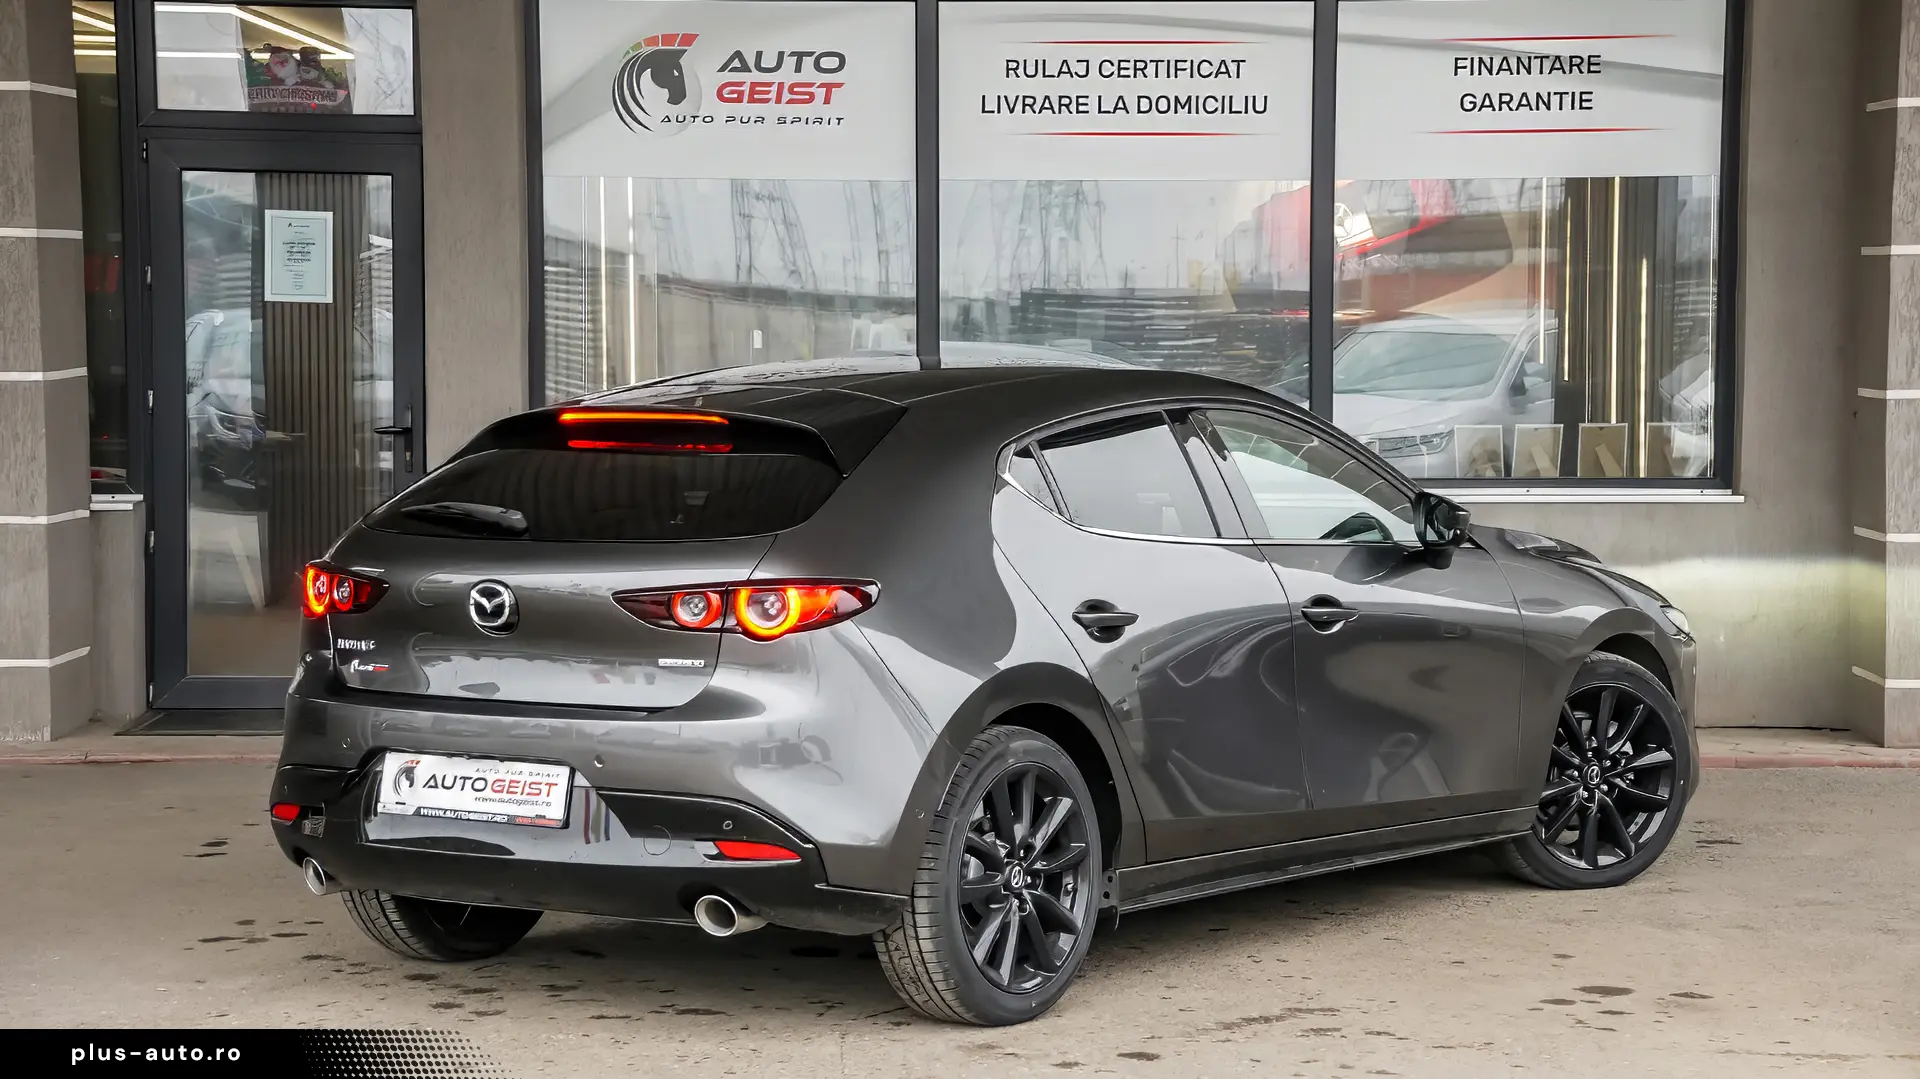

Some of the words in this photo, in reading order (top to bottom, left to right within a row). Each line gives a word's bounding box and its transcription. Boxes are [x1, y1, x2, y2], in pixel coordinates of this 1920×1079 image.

[716, 49, 847, 74] AUTO
[1004, 59, 1090, 79] RULAJ
[1098, 59, 1247, 79] CERTIFICAT
[1453, 55, 1602, 76] FINANTARE
[716, 81, 847, 105] GEIST
[1459, 91, 1594, 112] GARANTIE
[980, 95, 1090, 115] LIVRARE
[1097, 95, 1130, 115] LA
[1136, 95, 1269, 115] DOMICILIU
[660, 114, 715, 124] AUTO
[724, 115, 767, 125] PUR
[776, 116, 845, 126] SPIRIT
